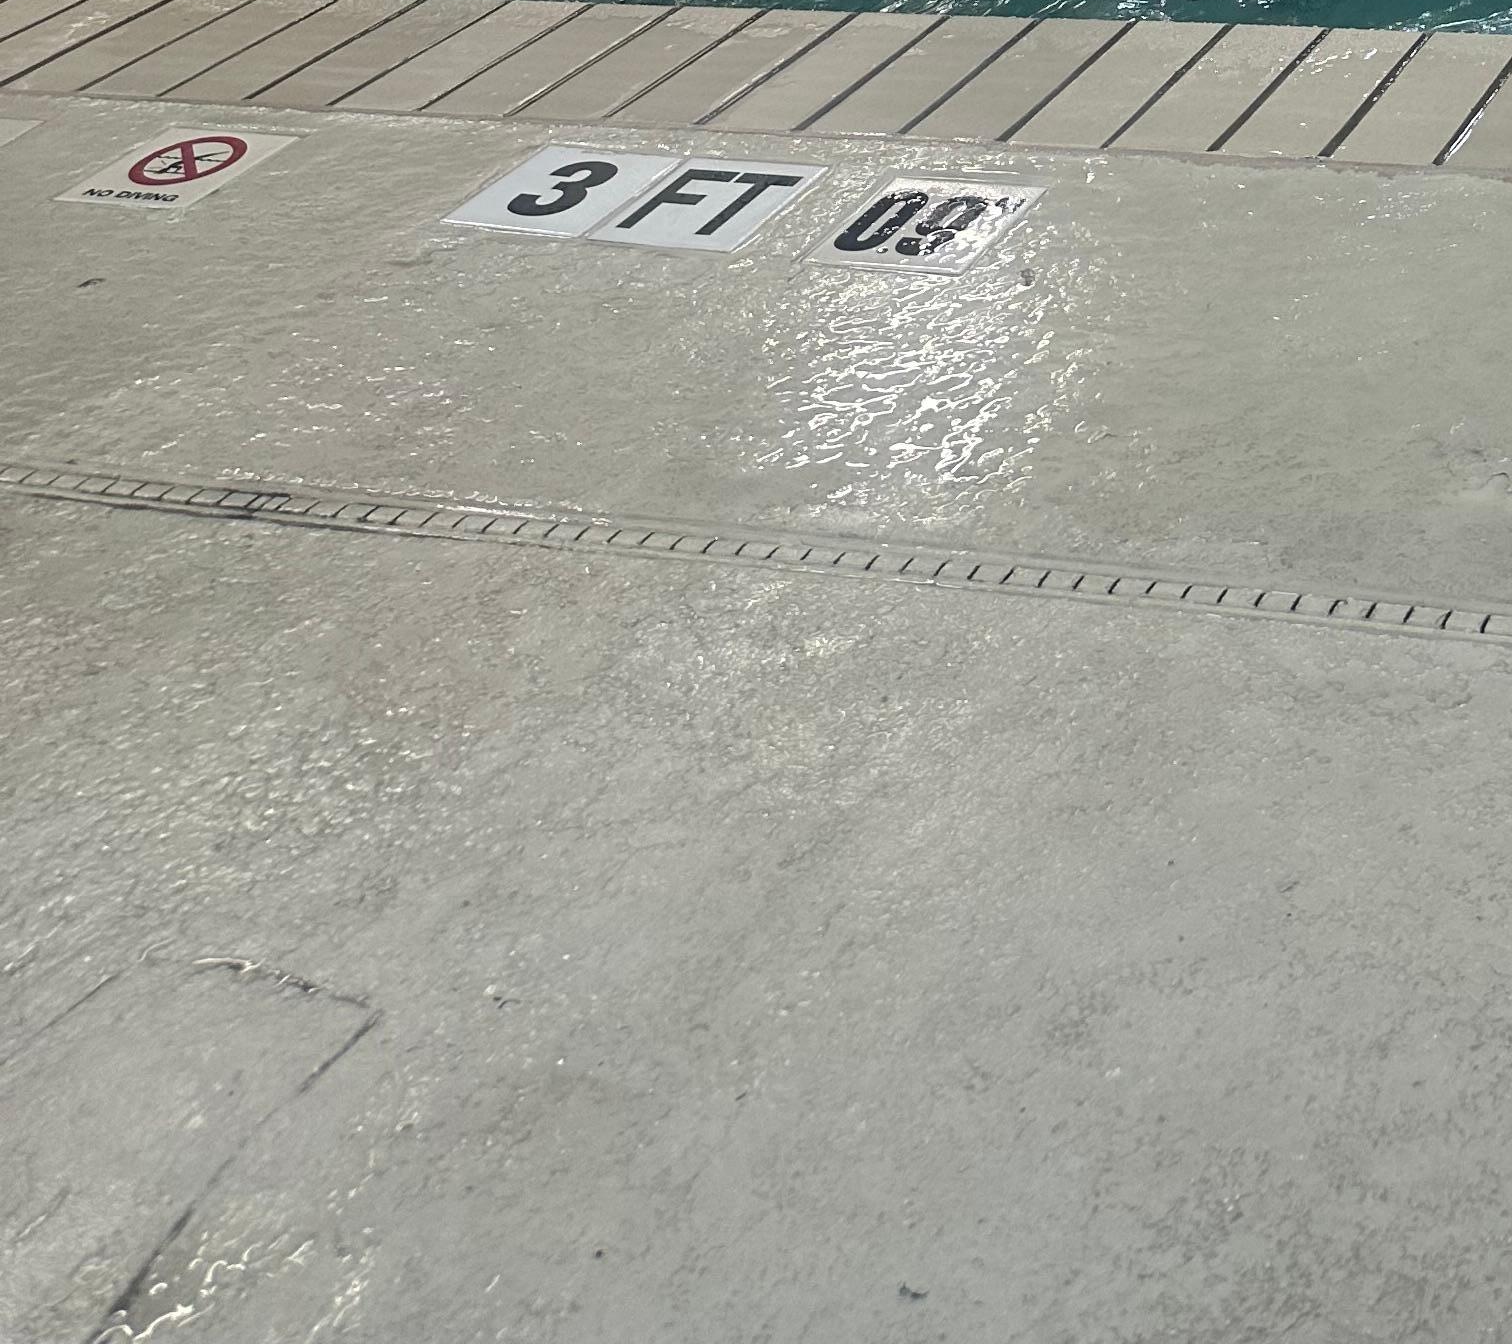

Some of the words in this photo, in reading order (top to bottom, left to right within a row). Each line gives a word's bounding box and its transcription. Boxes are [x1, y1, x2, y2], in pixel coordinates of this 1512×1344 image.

[82, 188, 115, 197] NO
[114, 191, 179, 202] DIVING
[507, 160, 619, 217] 3
[615, 168, 804, 236] FT
